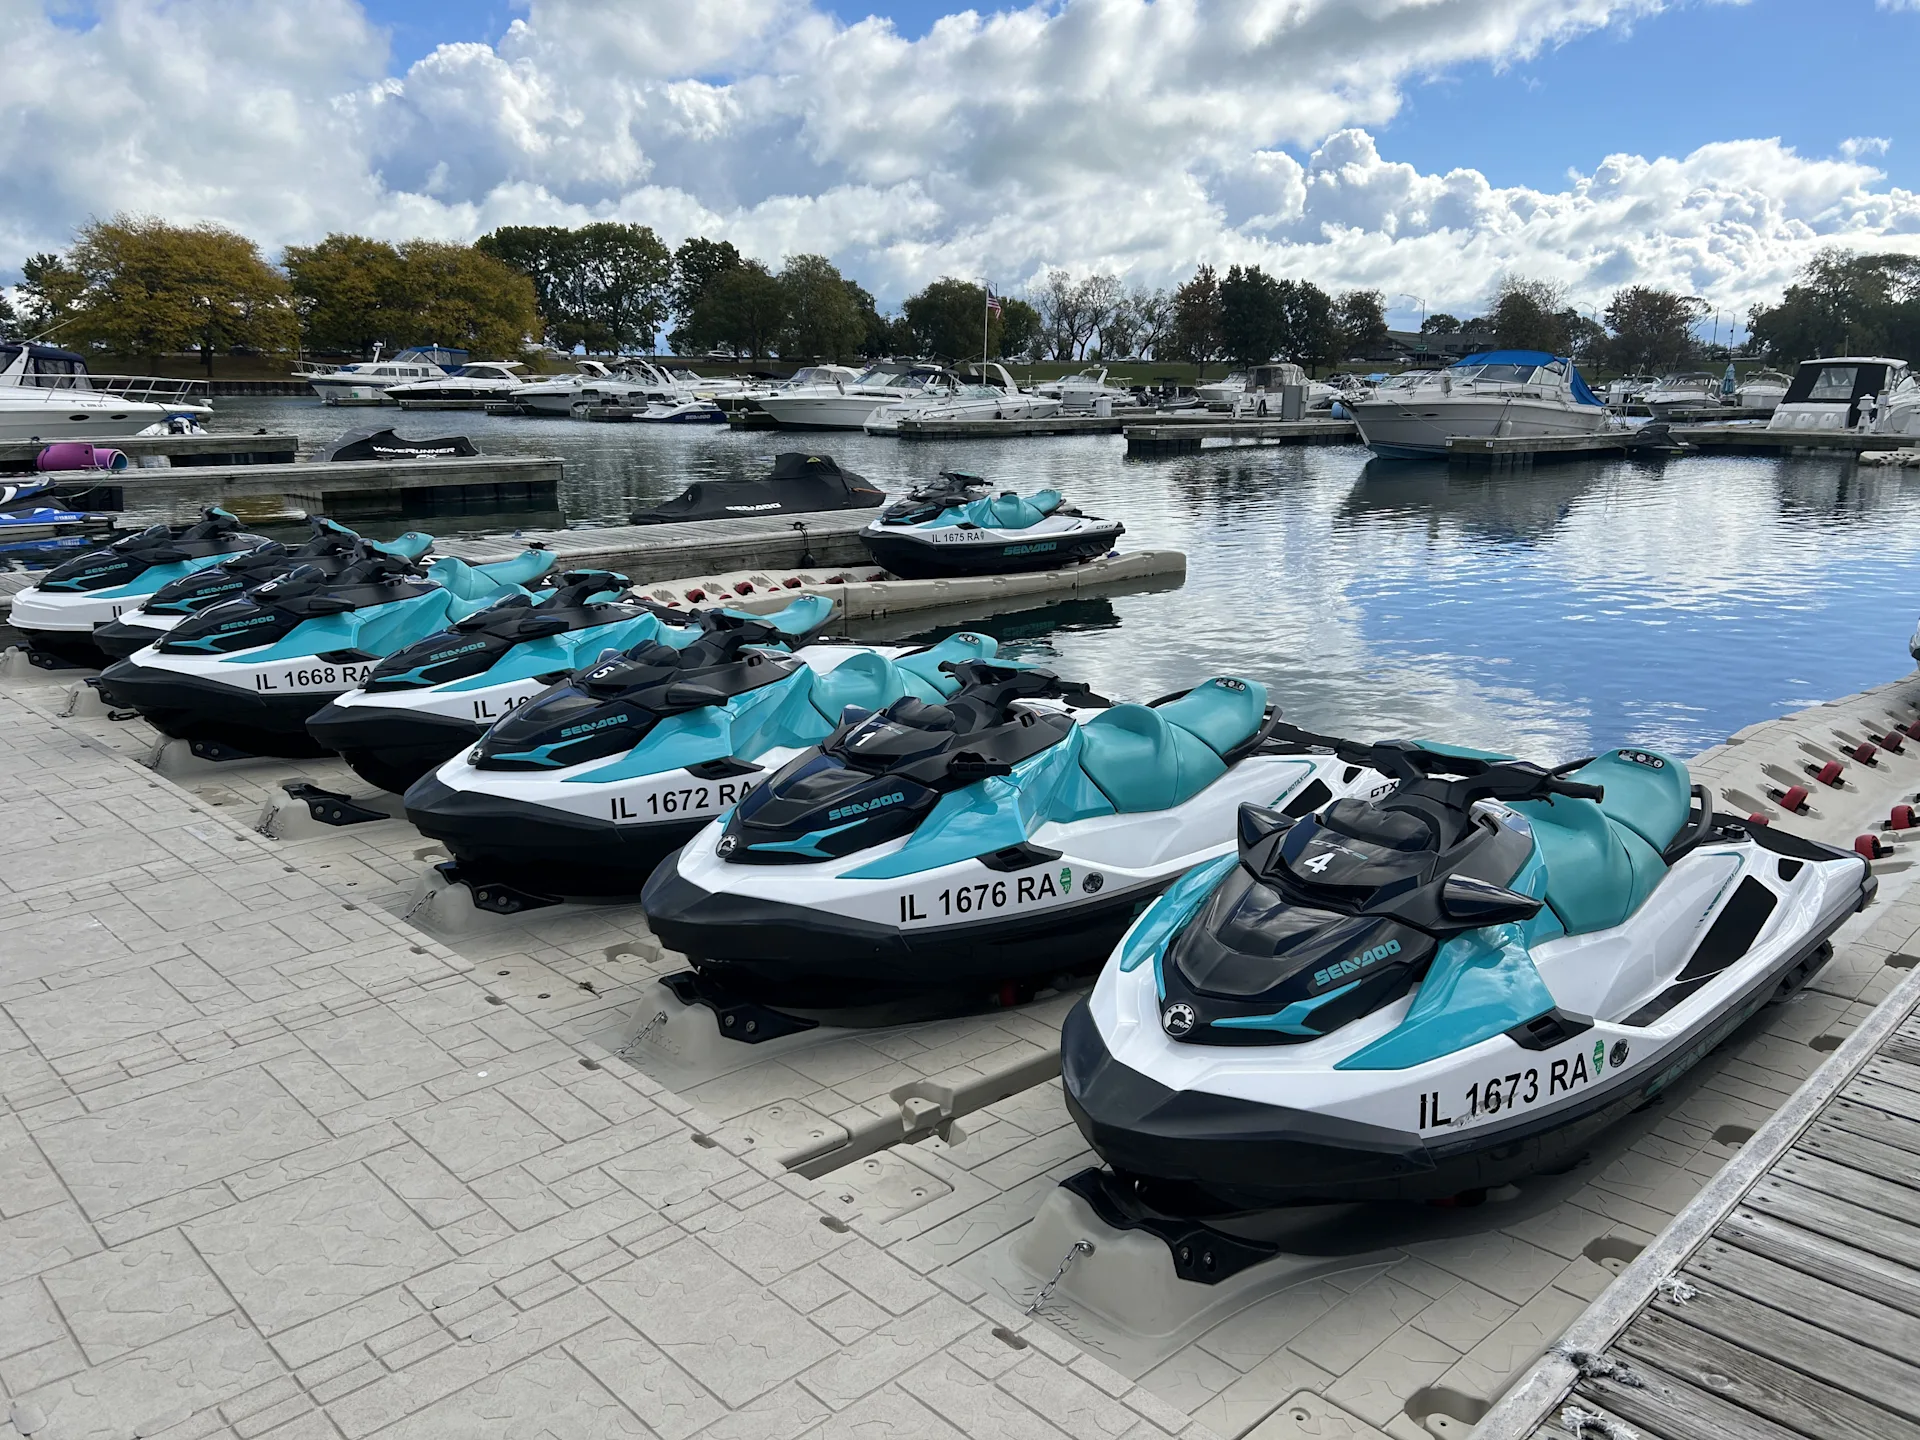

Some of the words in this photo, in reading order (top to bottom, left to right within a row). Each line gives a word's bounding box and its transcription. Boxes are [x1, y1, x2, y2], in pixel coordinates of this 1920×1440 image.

[932, 533, 941, 543] IL
[944, 532, 965, 542] 1675
[967, 532, 980, 541] RA
[256, 673, 278, 691] IL
[284, 667, 337, 688] 1668
[592, 666, 615, 679] 5
[473, 700, 497, 719] IL
[855, 731, 877, 747] 1
[611, 796, 638, 820] IL
[647, 787, 710, 815] 1672
[1303, 852, 1337, 874] 4
[900, 894, 927, 923] IL
[938, 881, 1007, 916] 1676
[1018, 873, 1057, 904] RA
[1419, 1091, 1452, 1130] IL
[1465, 1068, 1539, 1116] 1673
[1550, 1052, 1588, 1096] RA
